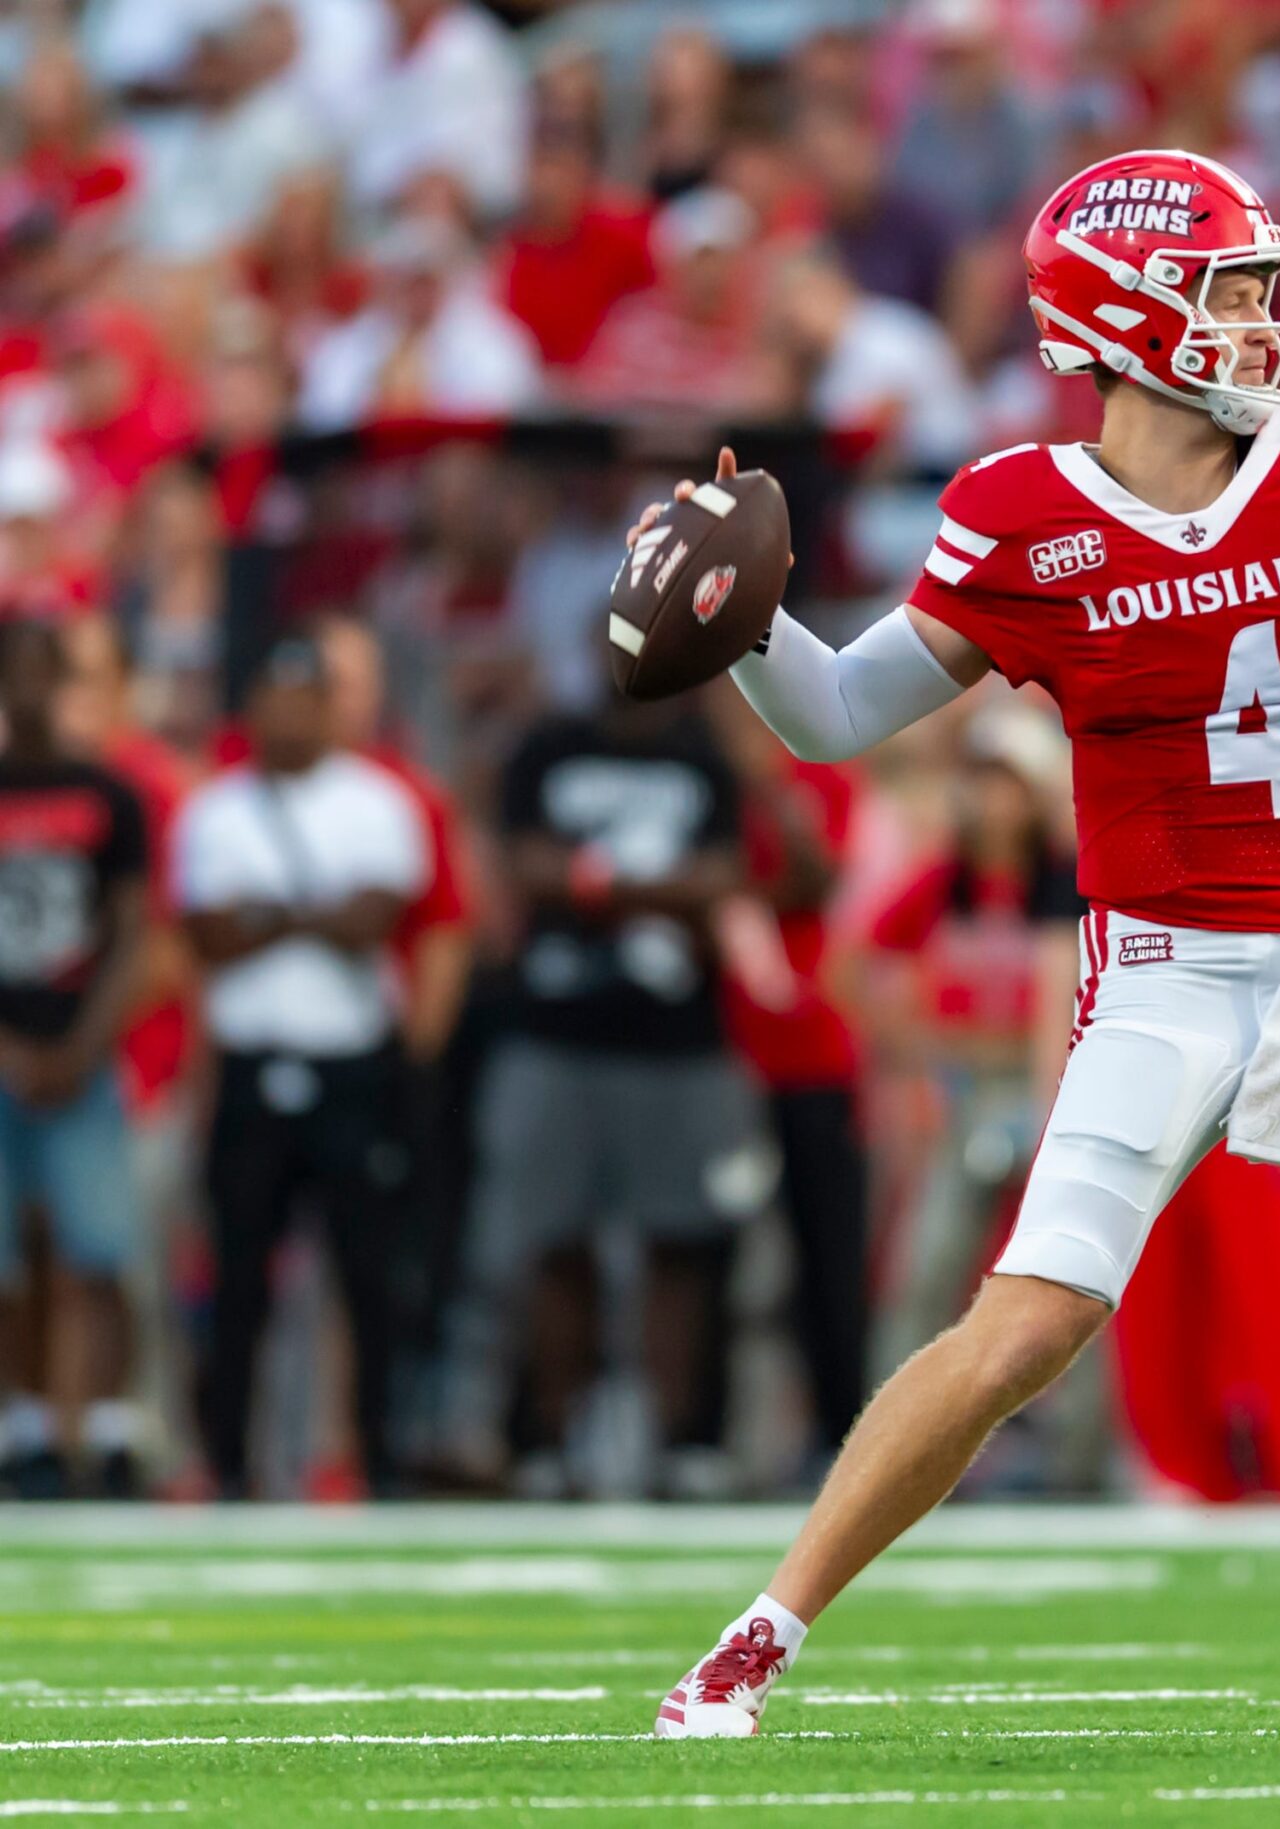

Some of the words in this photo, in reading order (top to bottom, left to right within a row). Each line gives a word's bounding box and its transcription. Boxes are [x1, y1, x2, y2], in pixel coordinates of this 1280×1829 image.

[1068, 203, 1192, 236] CAJUNS
[1028, 529, 1105, 584] SBC
[1120, 948, 1168, 963] CAJUNS
